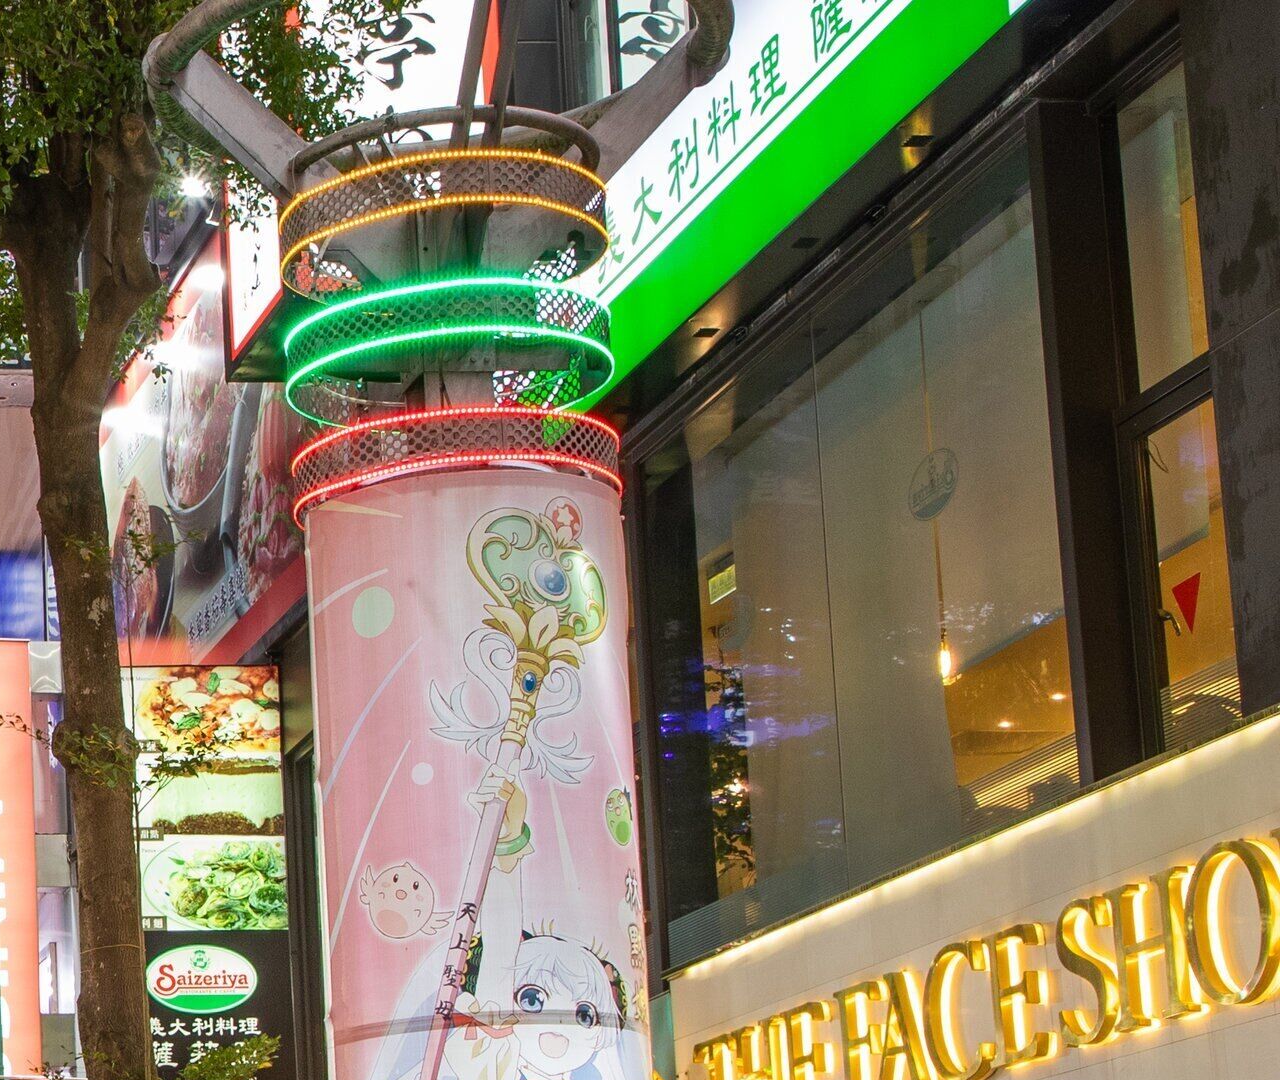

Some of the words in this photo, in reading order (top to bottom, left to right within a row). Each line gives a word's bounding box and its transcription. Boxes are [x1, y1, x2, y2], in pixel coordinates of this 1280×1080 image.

[1054, 828, 1280, 1049] SHO
[155, 963, 248, 993] Saizeriya
[150, 1017, 262, 1037] 義大利料理
